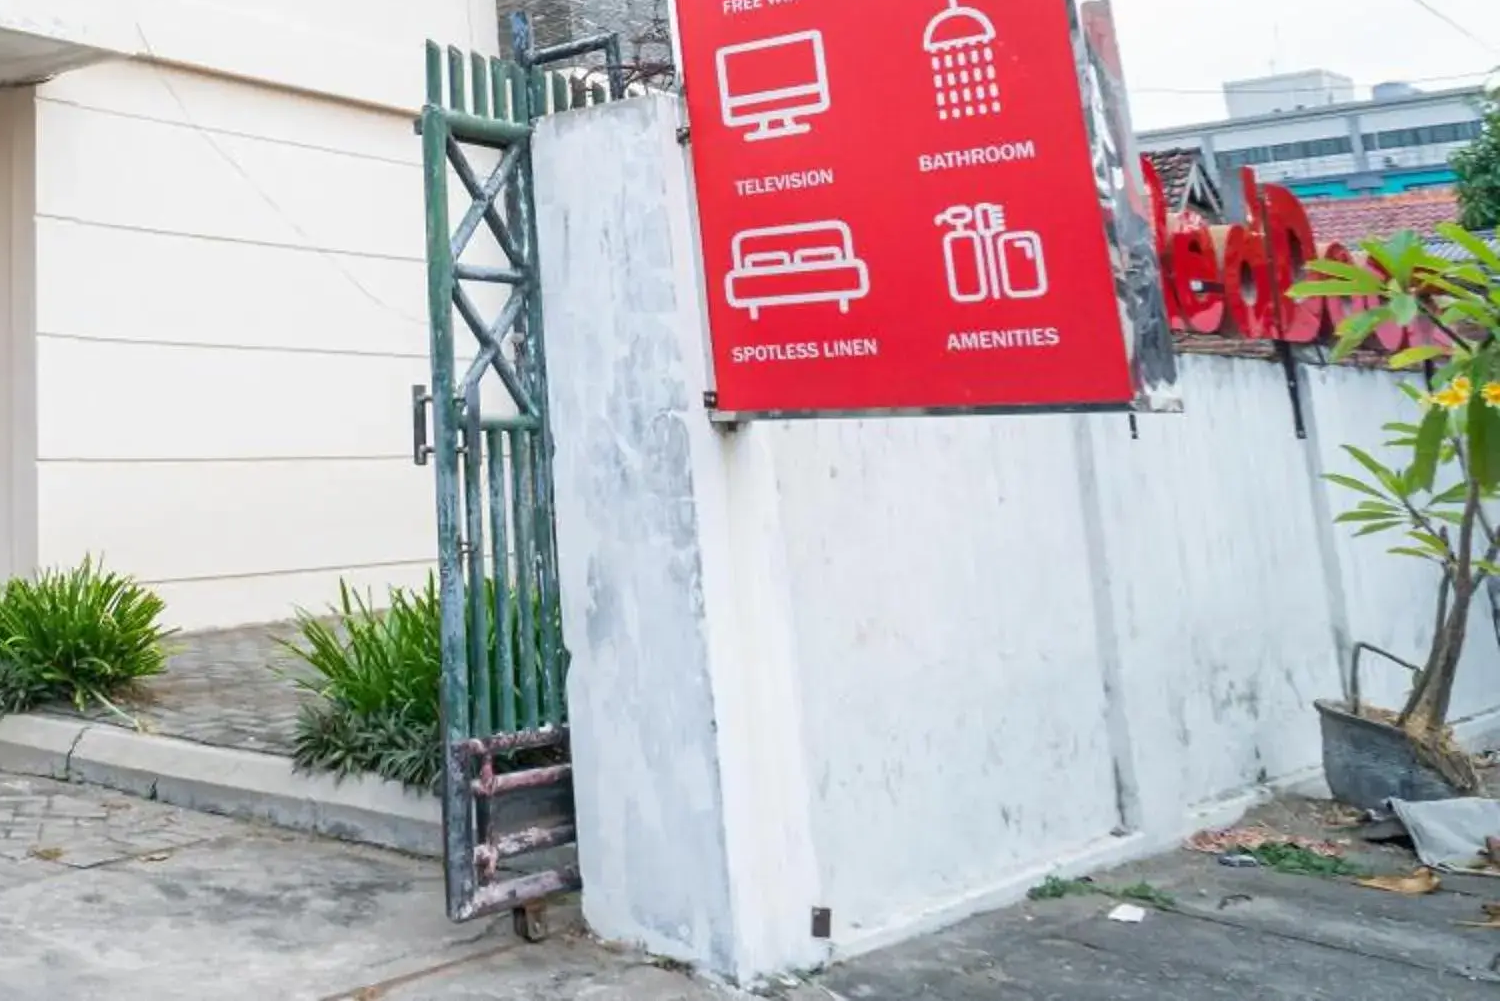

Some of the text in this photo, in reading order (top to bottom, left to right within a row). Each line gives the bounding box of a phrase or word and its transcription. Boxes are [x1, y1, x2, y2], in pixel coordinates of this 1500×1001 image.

[917, 140, 1036, 173] BATHROOM
[735, 168, 835, 197] TELEVISION
[731, 337, 879, 363] SPOTLESS LINEN
[946, 326, 1061, 352] AMENITIES
